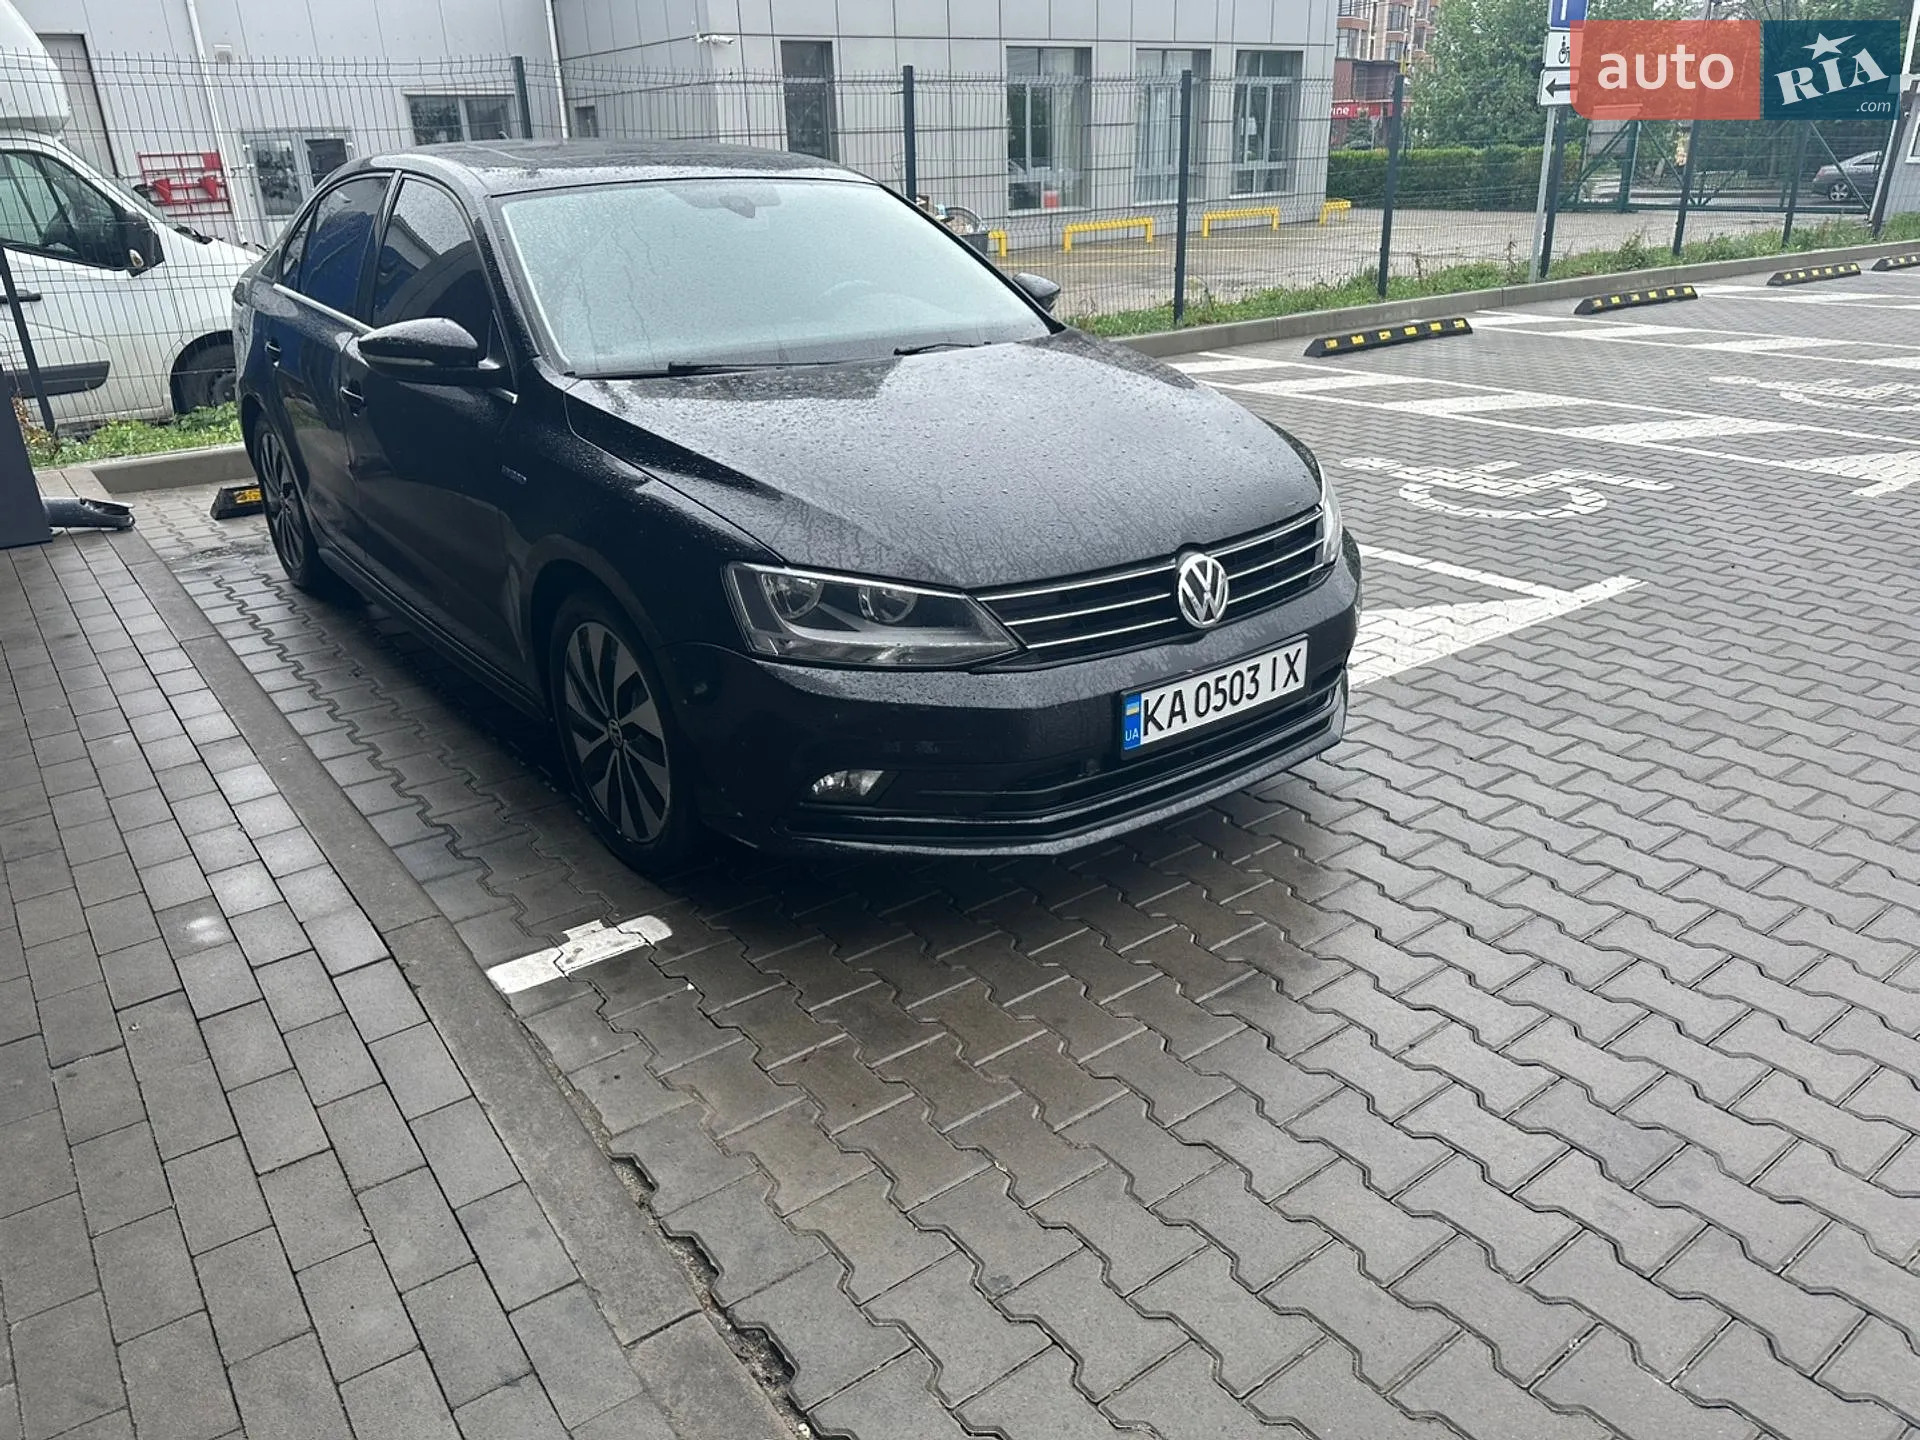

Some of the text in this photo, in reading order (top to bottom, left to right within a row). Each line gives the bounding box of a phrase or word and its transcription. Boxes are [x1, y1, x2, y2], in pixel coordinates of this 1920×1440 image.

[1329, 107, 1350, 115] ine
[1143, 648, 1302, 736] KA 0503 IX
[1124, 727, 1140, 742] UA
